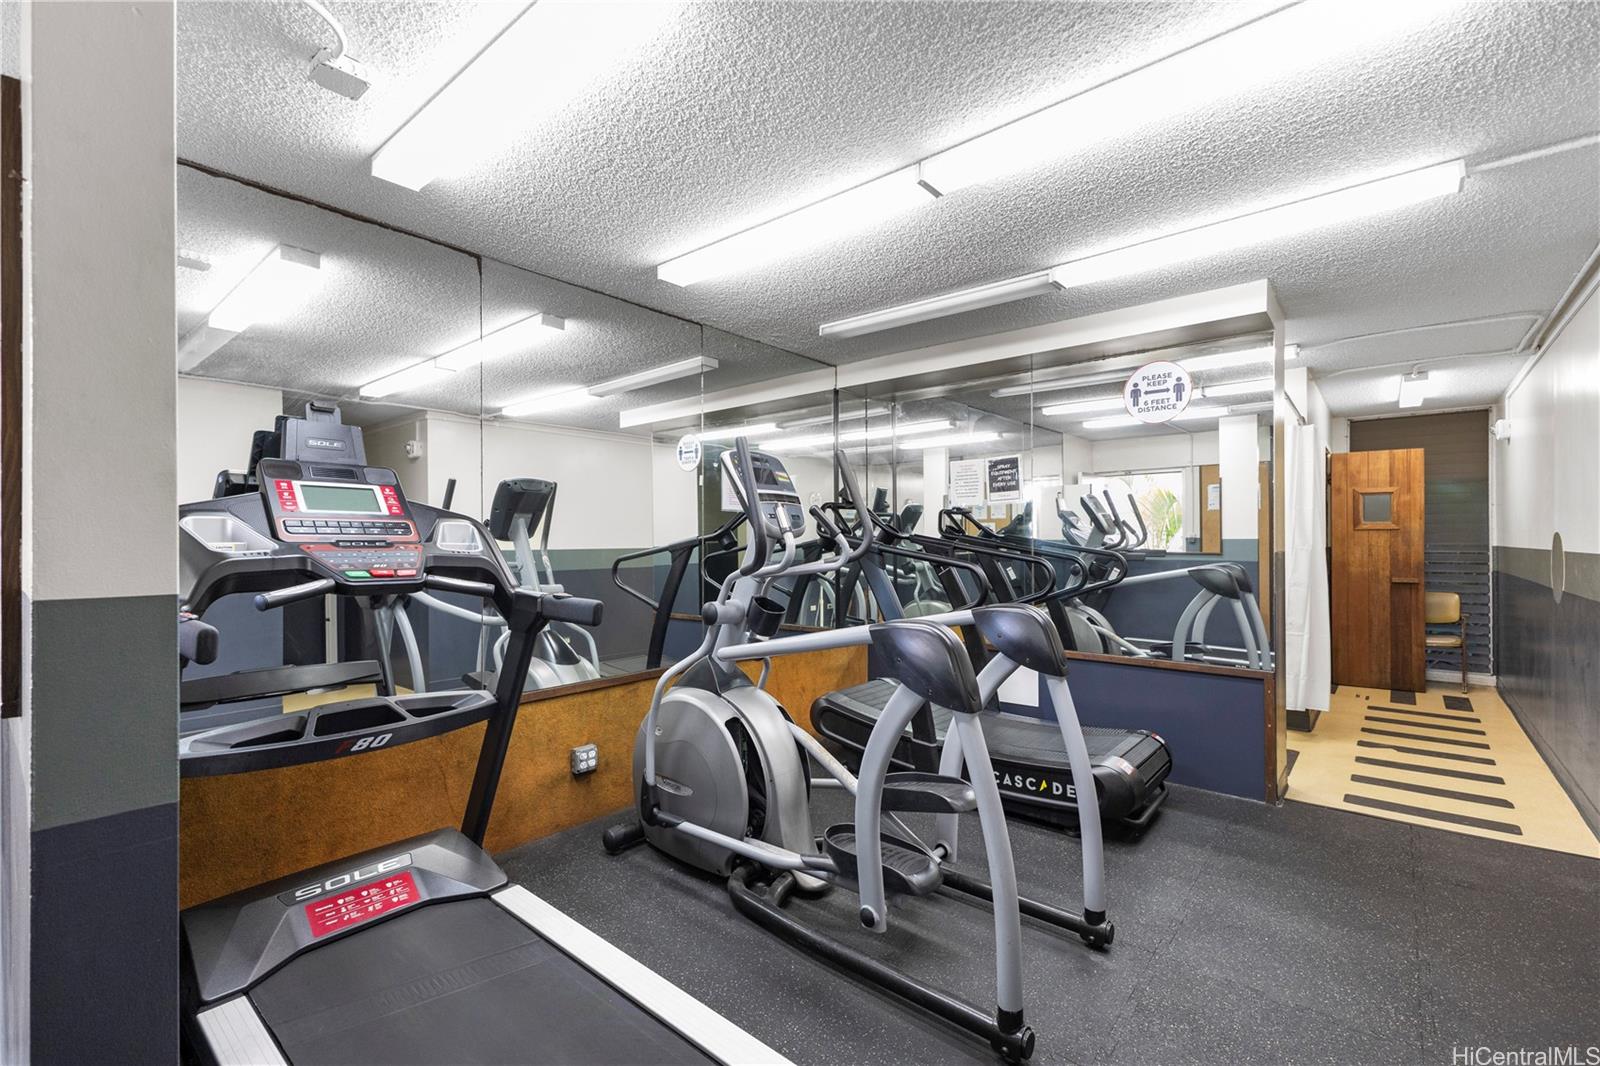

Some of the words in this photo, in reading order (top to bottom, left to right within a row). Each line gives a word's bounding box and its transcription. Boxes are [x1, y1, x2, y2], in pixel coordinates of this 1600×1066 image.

[1142, 372, 1173, 382] PLEASE
[1137, 403, 1177, 413] DISTANCE
[308, 440, 341, 448] SOLE
[295, 857, 402, 901] SOLE
